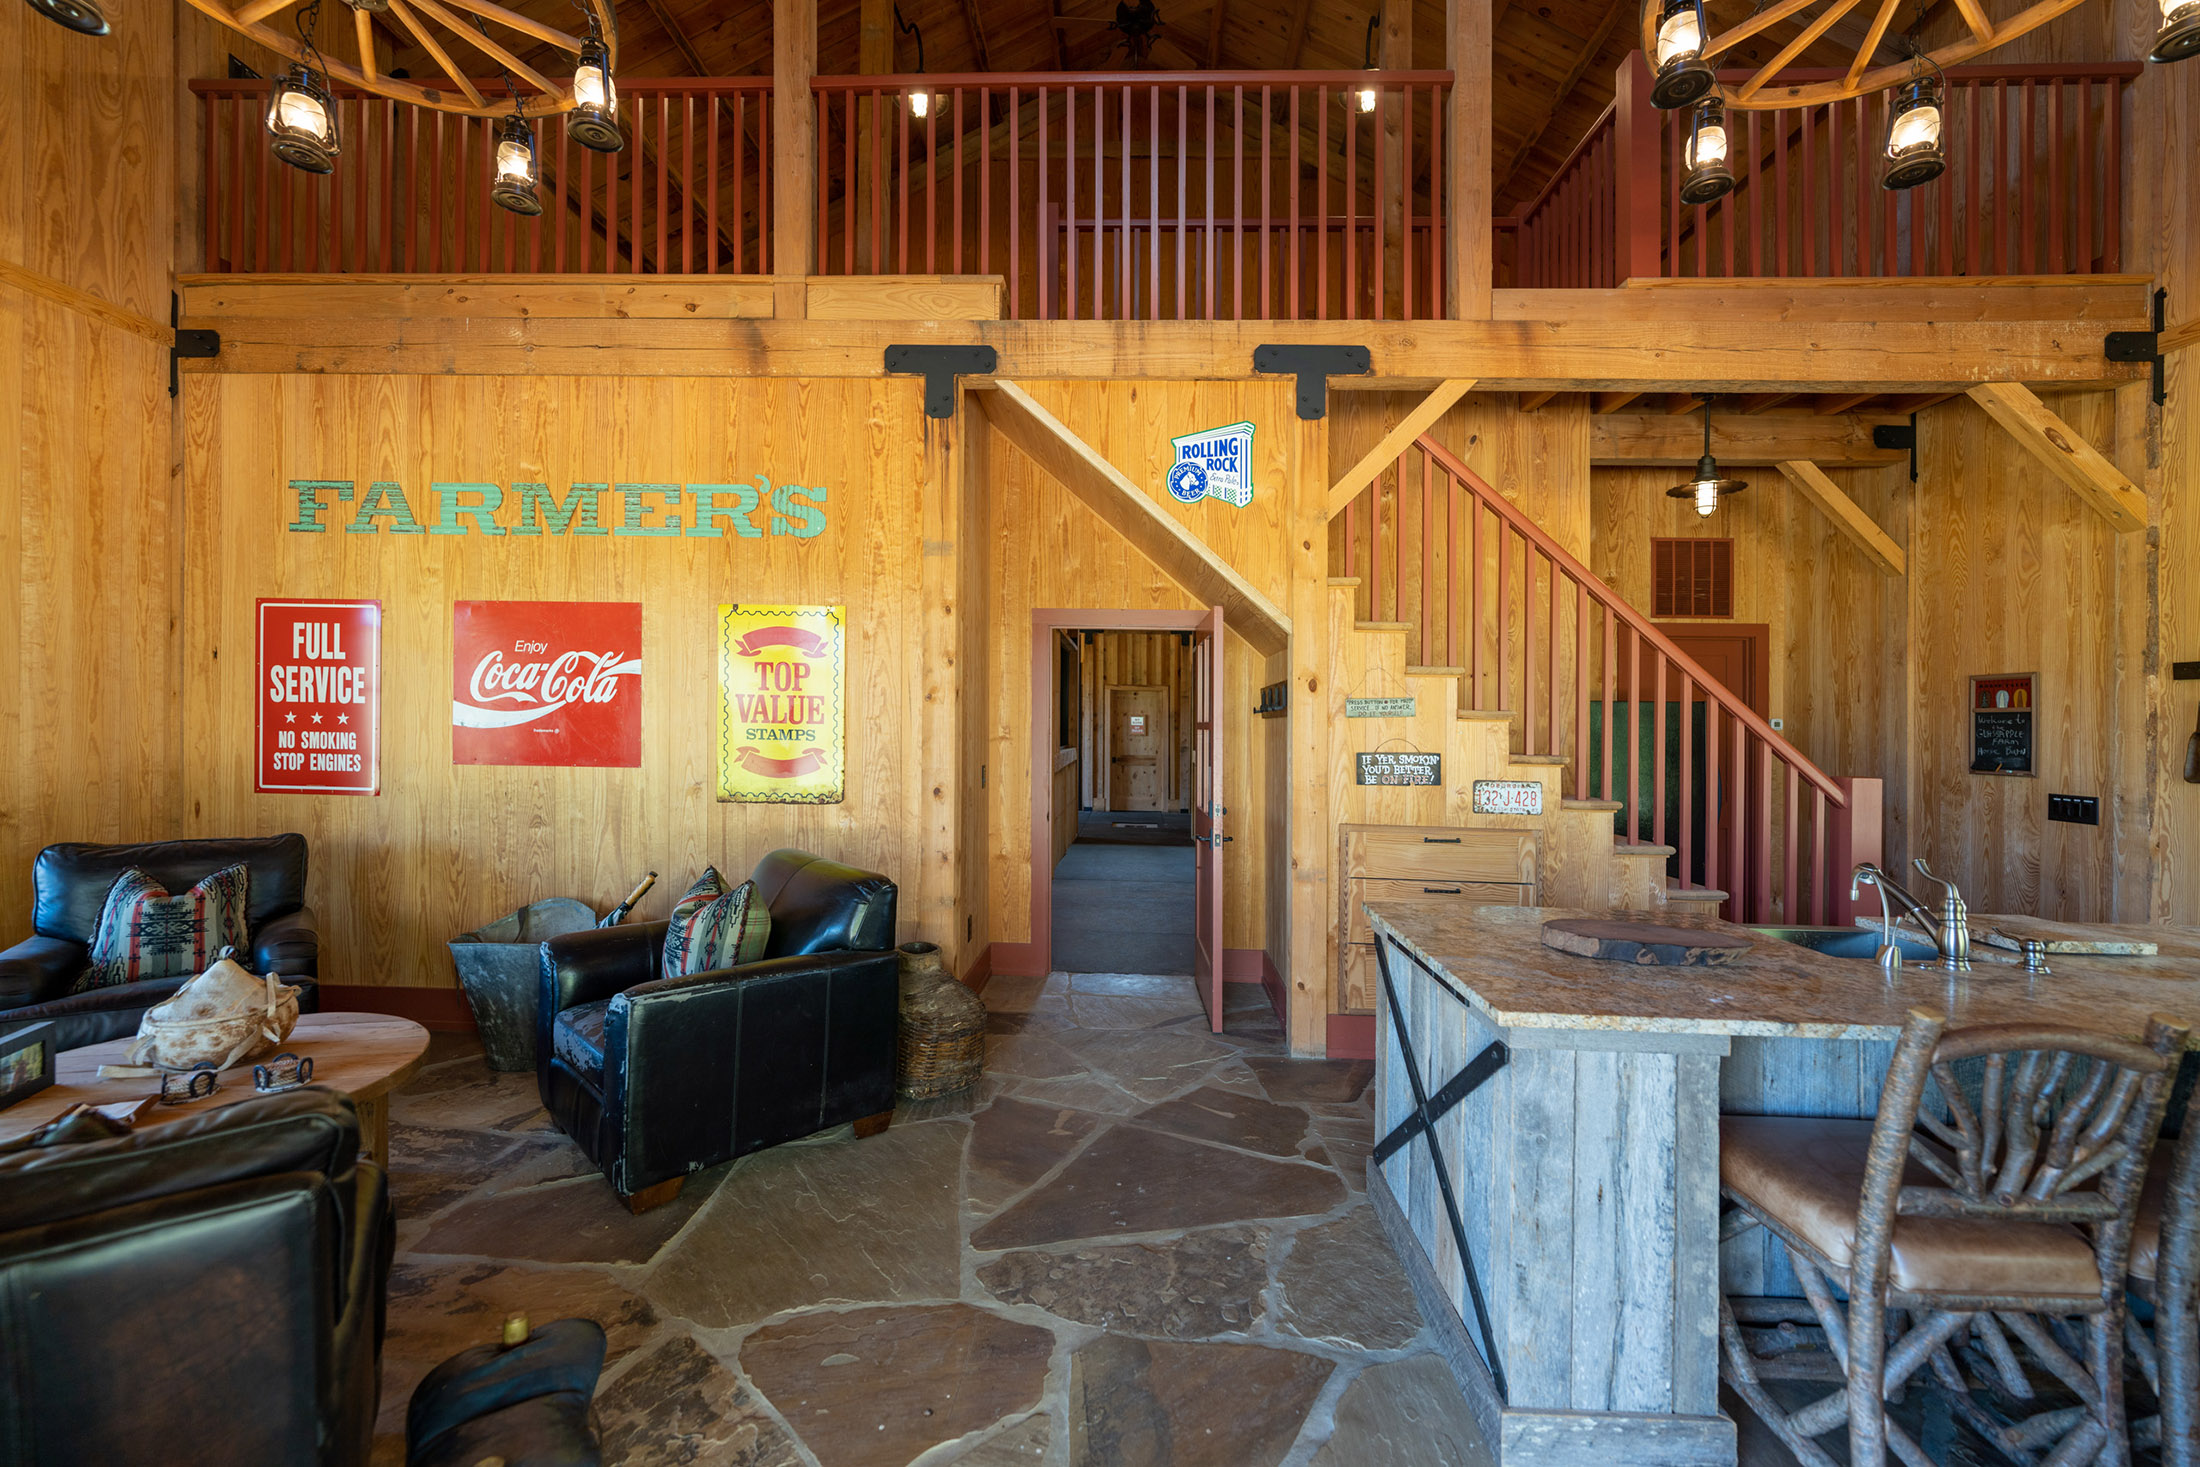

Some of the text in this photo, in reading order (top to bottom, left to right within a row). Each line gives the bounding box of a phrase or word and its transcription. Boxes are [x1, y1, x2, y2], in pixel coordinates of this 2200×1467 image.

[1182, 437, 1238, 459] ROLLING
[1174, 466, 1202, 479] PREMIUM
[1206, 457, 1238, 473] ROCK
[1182, 489, 1199, 497] BEER
[288, 474, 827, 538] FARMER'S
[293, 622, 346, 660] FULL
[515, 640, 548, 654] Enjoy
[270, 665, 366, 704] SERVICE
[470, 651, 624, 703] Coca-Cola
[754, 662, 810, 692] TOP
[735, 694, 825, 725] VALUE
[278, 731, 357, 750] NO SMOKING
[746, 728, 816, 741] STAMPS
[273, 752, 362, 772] STOP ENGINES
[1361, 755, 1372, 764] IF
[1375, 754, 1396, 765] YER
[1362, 765, 1433, 775] YOU'D BETTER
[1365, 774, 1435, 785] BE ON FIRE!
